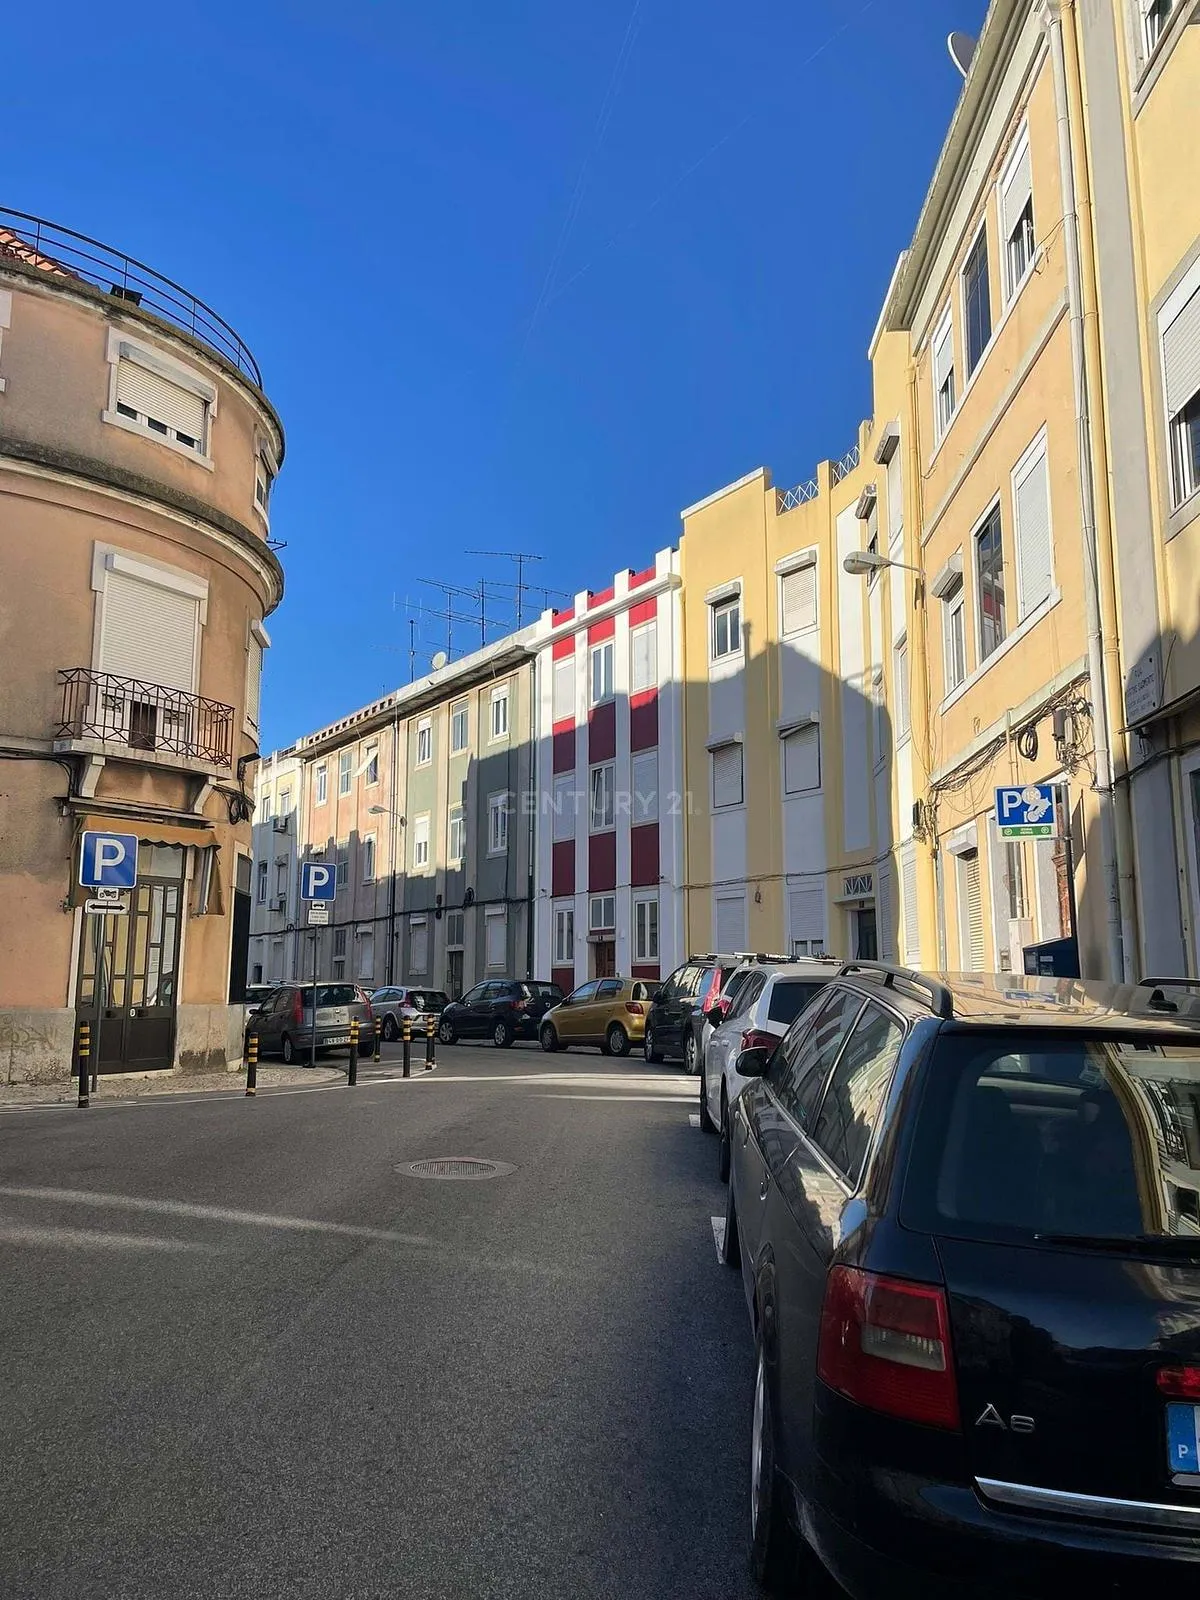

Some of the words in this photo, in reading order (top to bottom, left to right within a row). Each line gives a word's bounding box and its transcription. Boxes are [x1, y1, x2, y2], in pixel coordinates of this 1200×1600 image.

[1002, 790, 1022, 817] P
[93, 837, 126, 881] P
[308, 865, 329, 897] P
[1177, 1443, 1189, 1459] P
